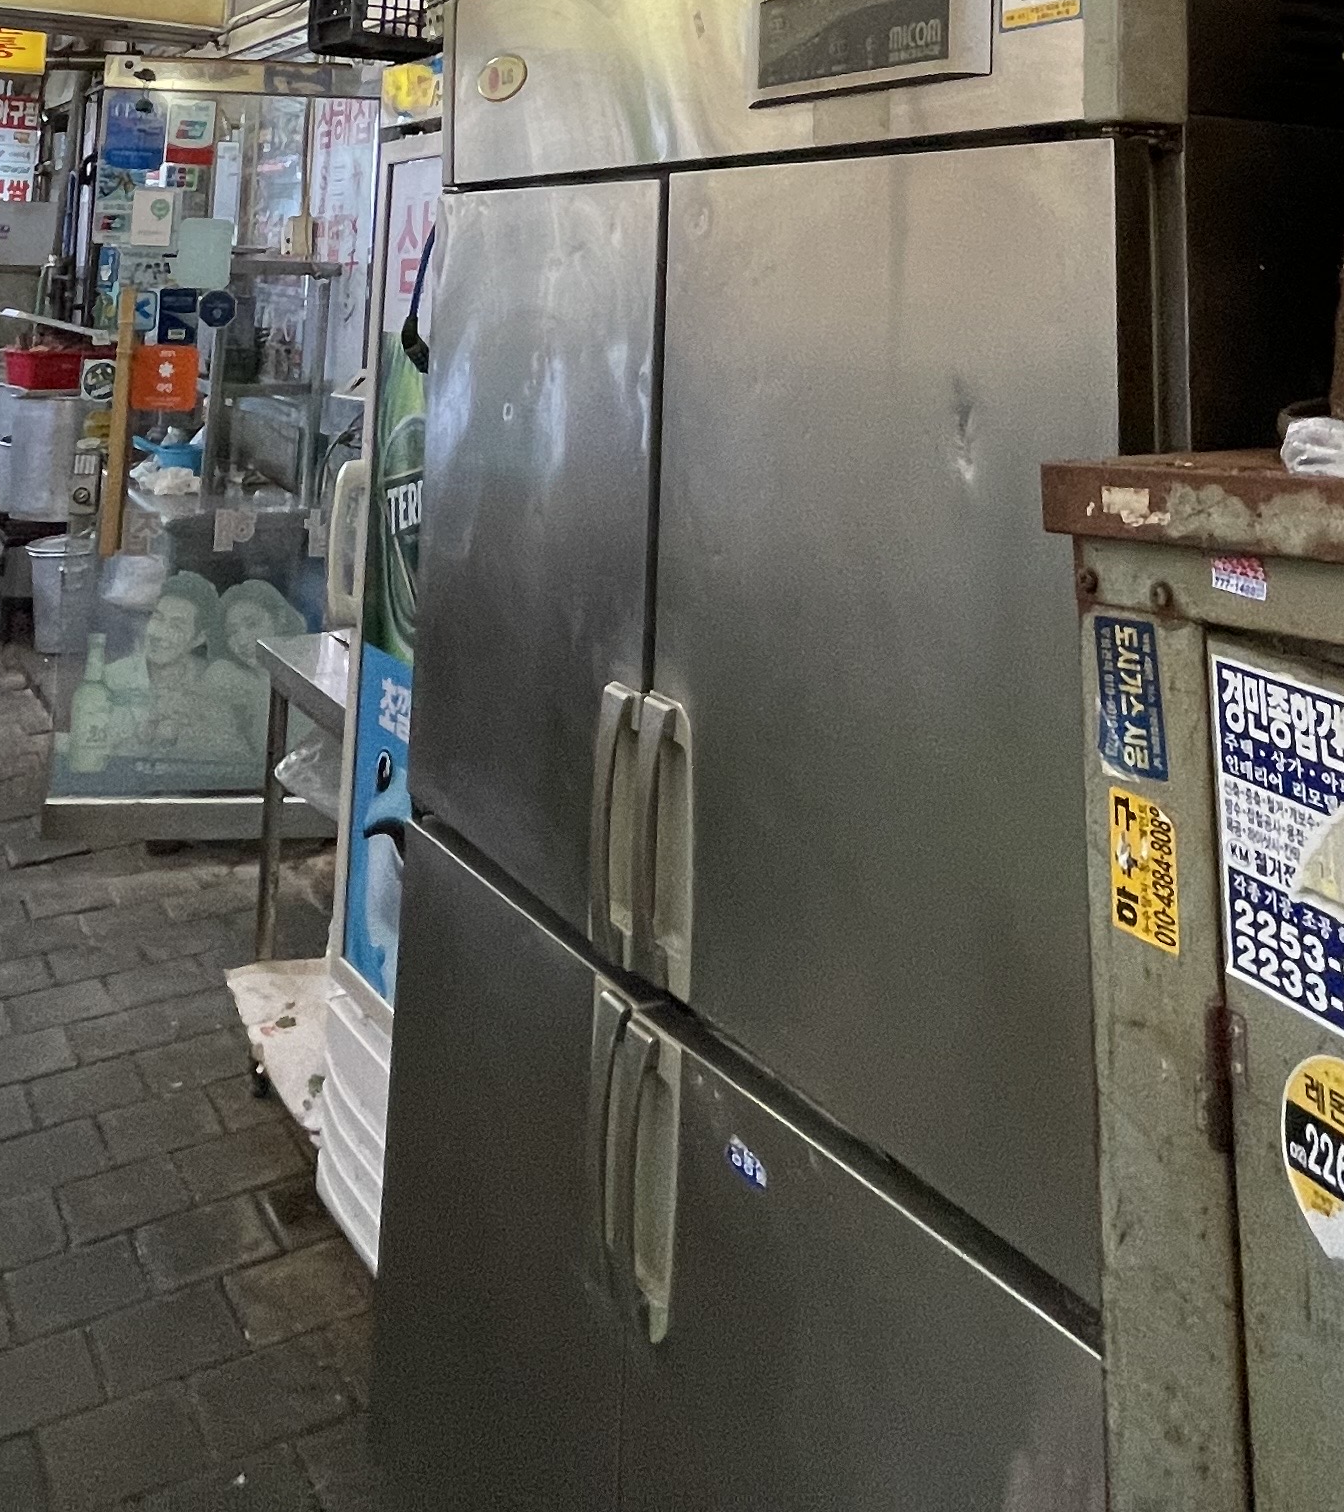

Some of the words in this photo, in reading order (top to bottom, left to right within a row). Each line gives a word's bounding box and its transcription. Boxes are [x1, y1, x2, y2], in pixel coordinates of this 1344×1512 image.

[1115, 624, 1144, 716] 도시가스
[1123, 720, 1150, 771] 시공
[1225, 732, 1254, 760] 주택
[1270, 750, 1304, 775] 상가
[1226, 755, 1284, 795] 인테리어
[1230, 842, 1250, 863] KM
